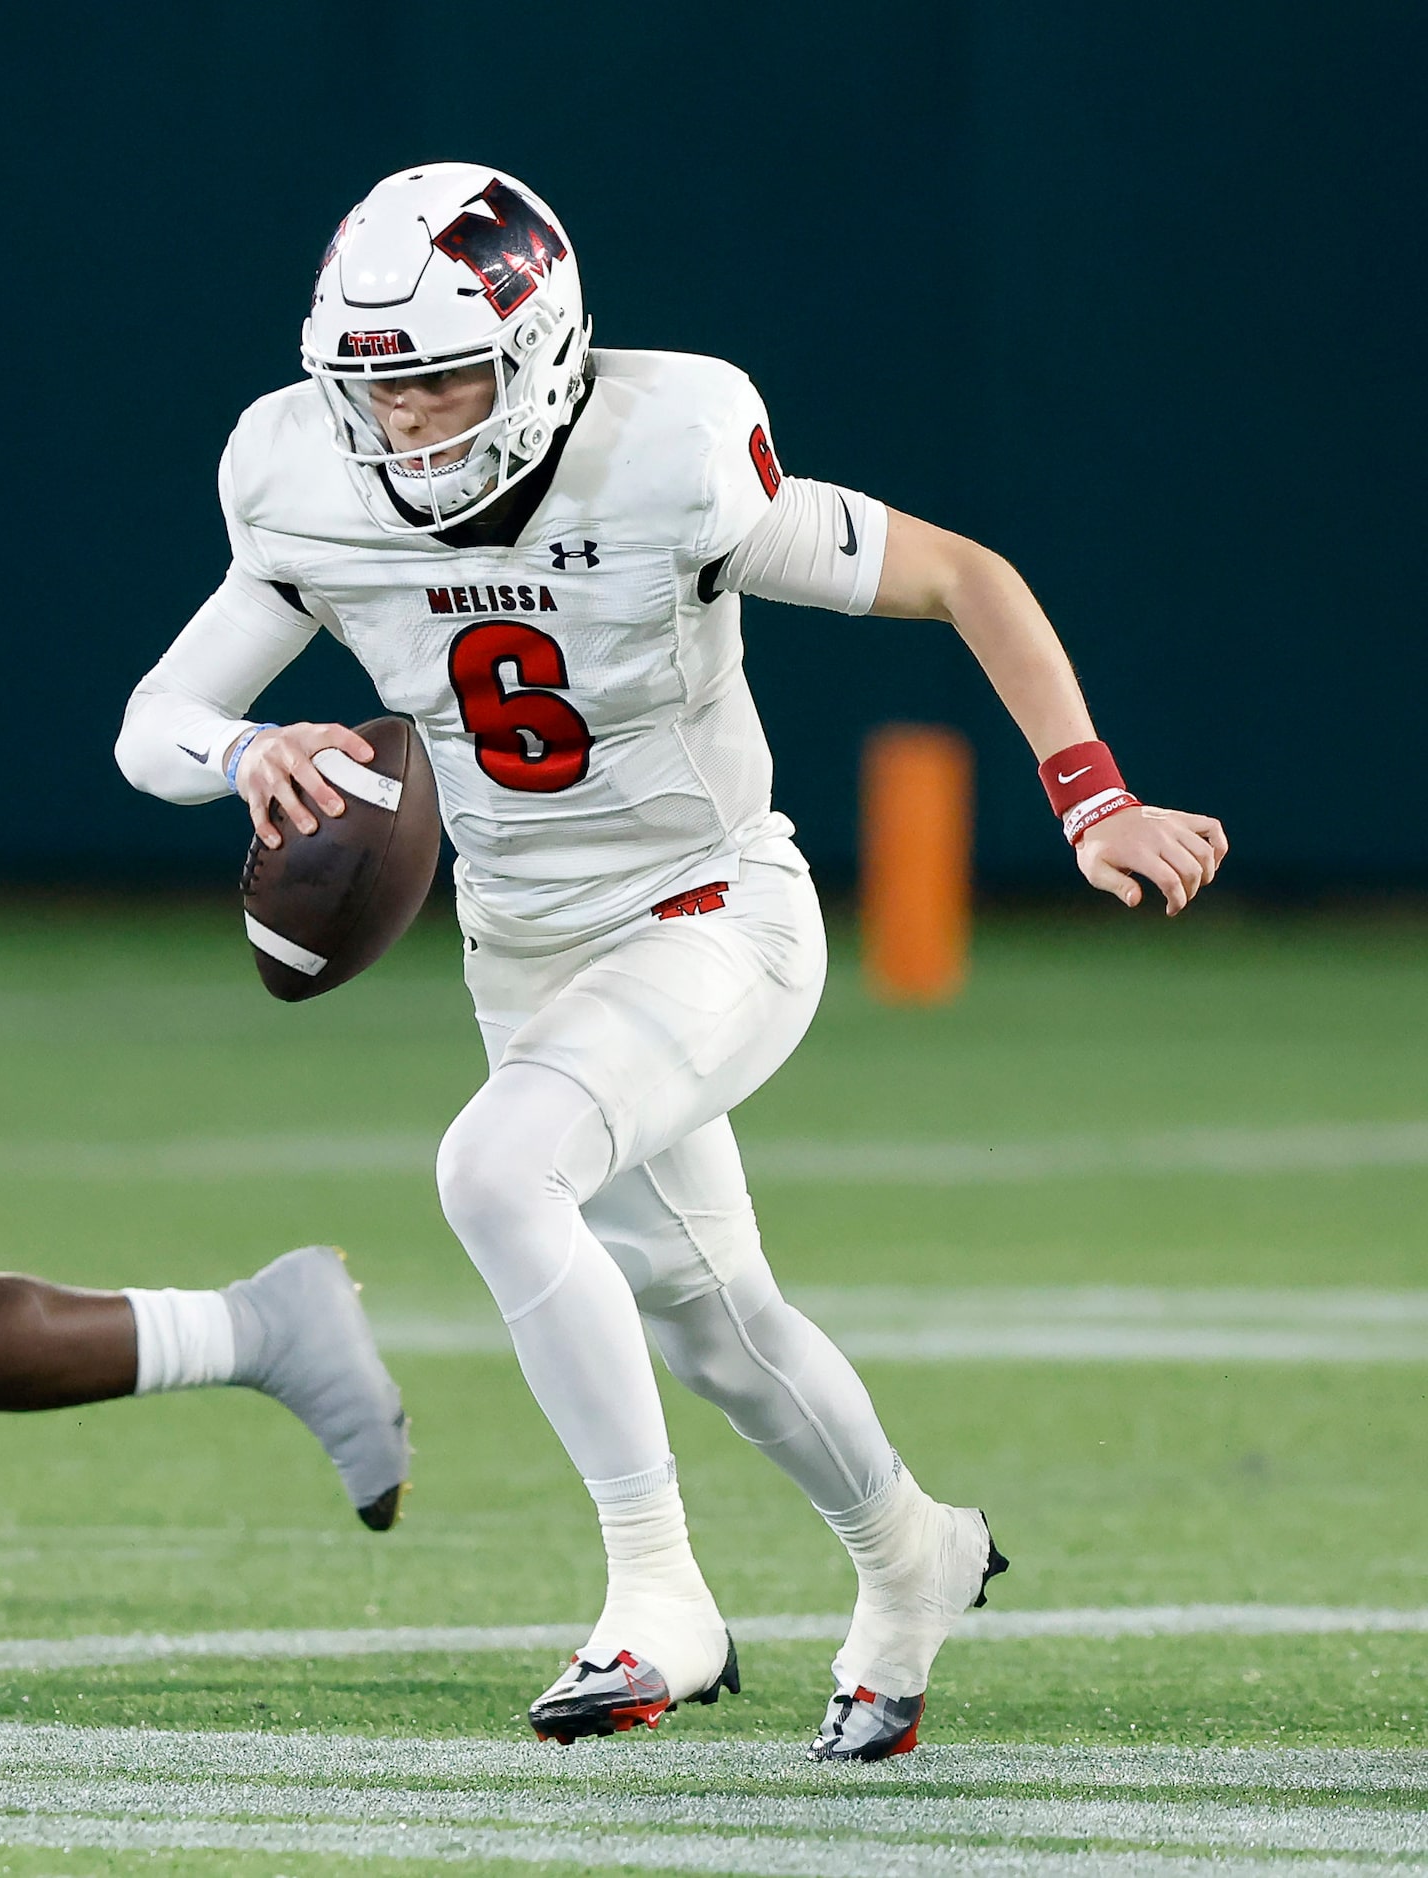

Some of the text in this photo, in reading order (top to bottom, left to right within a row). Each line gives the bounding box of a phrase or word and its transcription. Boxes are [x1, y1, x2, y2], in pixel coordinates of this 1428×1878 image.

[432, 176, 568, 322] M
[348, 332, 400, 357] TTH
[748, 423, 781, 502] 6
[425, 585, 558, 614] MELISSA
[448, 619, 596, 793] 6
[1085, 811, 1100, 824] PIG
